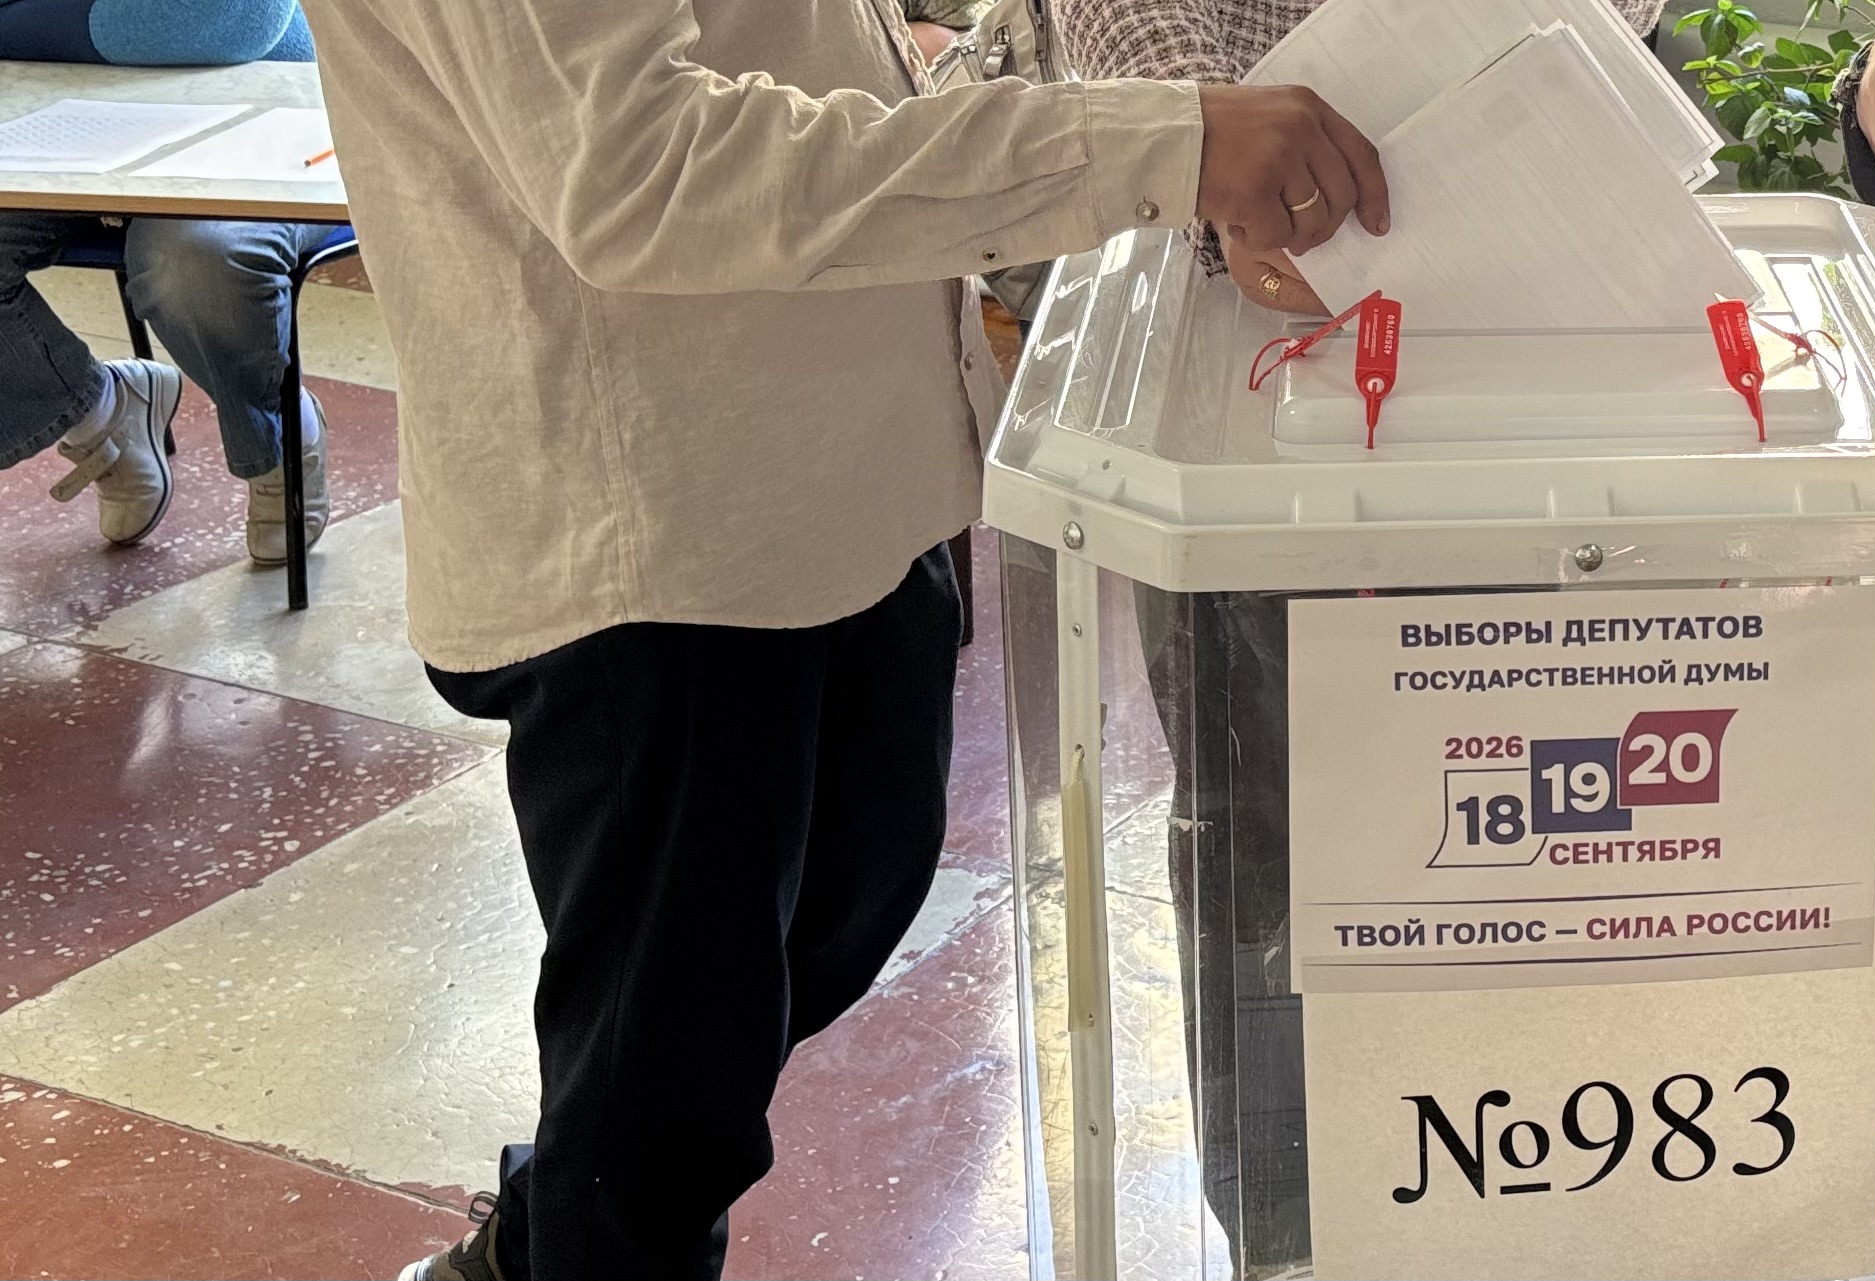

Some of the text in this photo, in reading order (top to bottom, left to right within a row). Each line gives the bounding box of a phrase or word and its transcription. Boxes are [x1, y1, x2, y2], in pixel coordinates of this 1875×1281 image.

[1400, 615, 1763, 649] ВЫБОРЫ ДЕПУТАТОВ
[1394, 659, 1770, 692] ГОСУДАРСТВЕННОЙ ДУМЫ
[1444, 736, 1524, 760] 2026
[1455, 731, 1713, 846] 18 19 20
[1548, 837, 1722, 866] СЕНТЯБРЯ
[1334, 918, 1426, 947] ТВОЙ
[1436, 920, 1547, 946] ГОЛОС
[1586, 915, 1678, 942] СИЛА
[1686, 906, 1831, 936] РОССИИ!
[1392, 1066, 1796, 1205] №983
